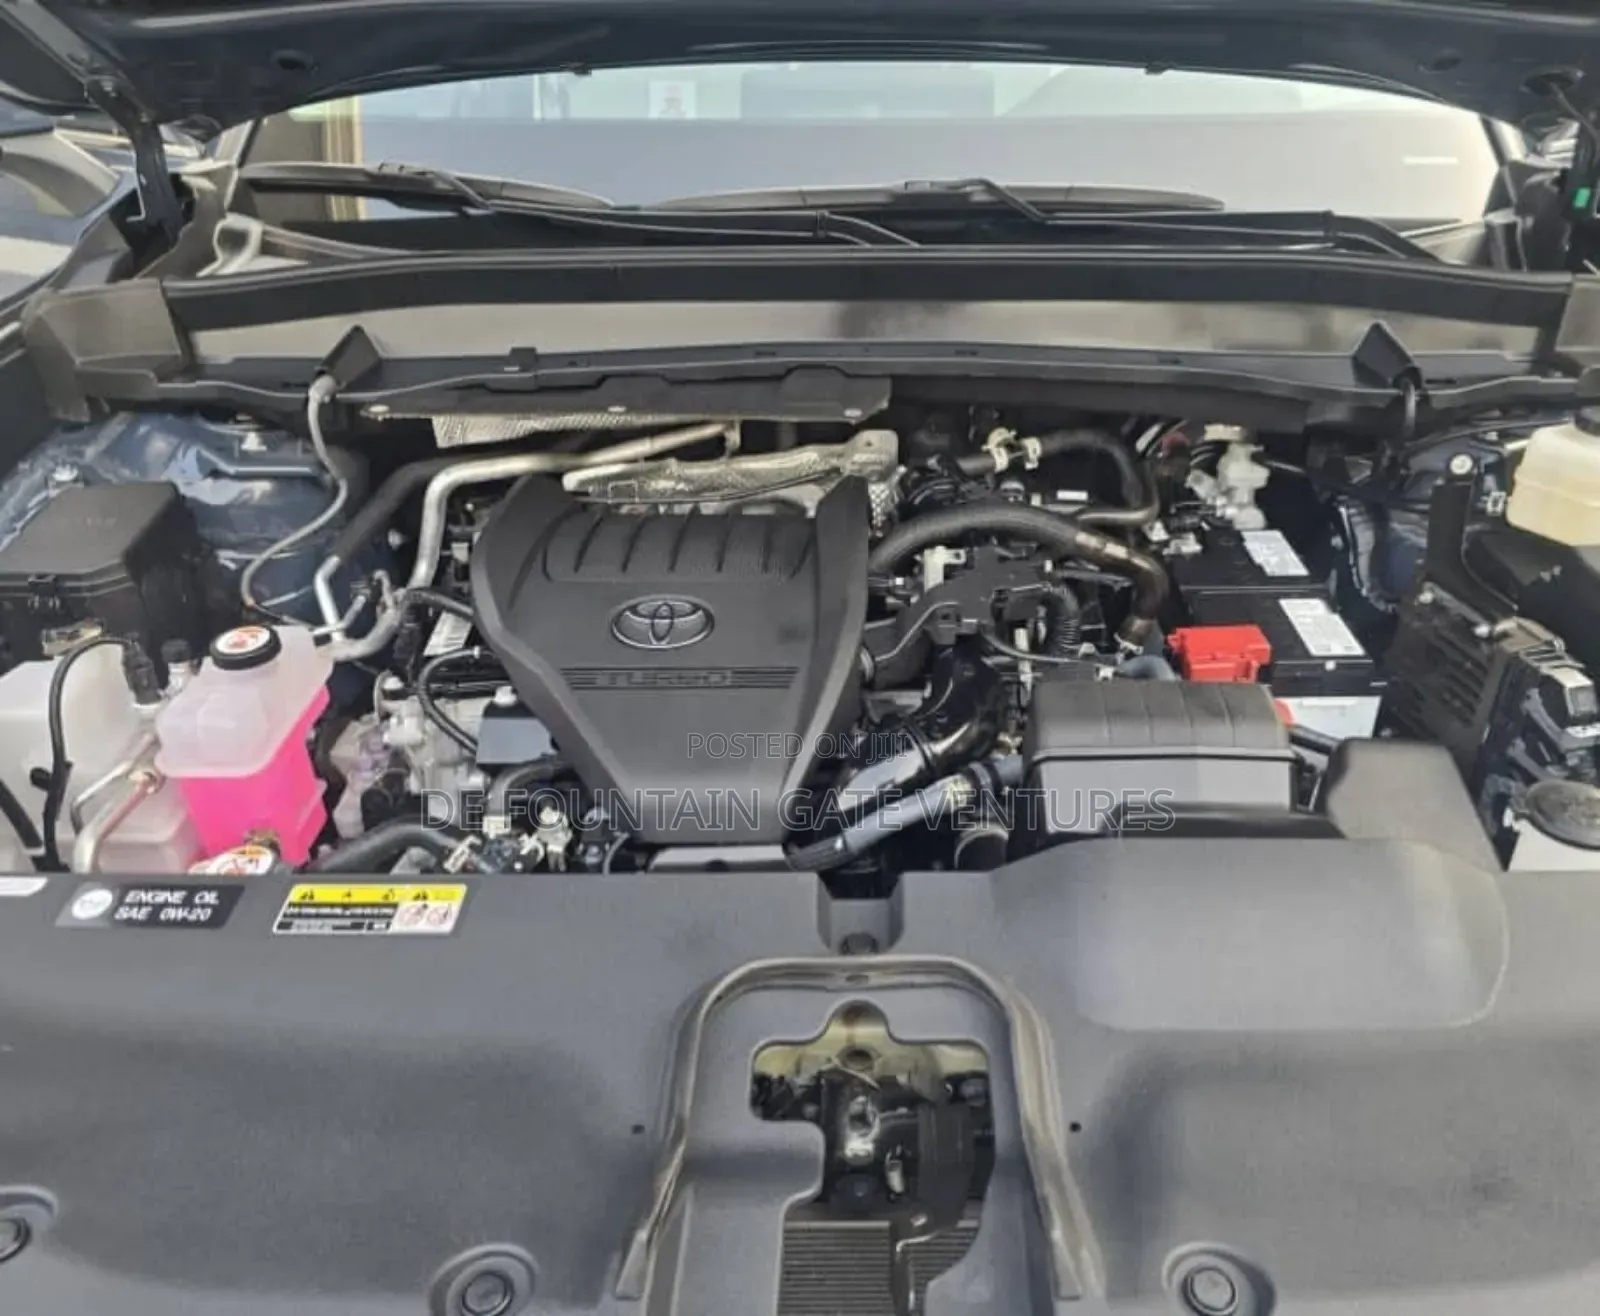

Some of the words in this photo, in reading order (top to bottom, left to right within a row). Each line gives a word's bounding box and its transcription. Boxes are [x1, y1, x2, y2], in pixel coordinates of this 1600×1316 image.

[124, 888, 188, 905] ENGINE
[193, 889, 220, 905] OIL
[113, 905, 152, 921] SAE
